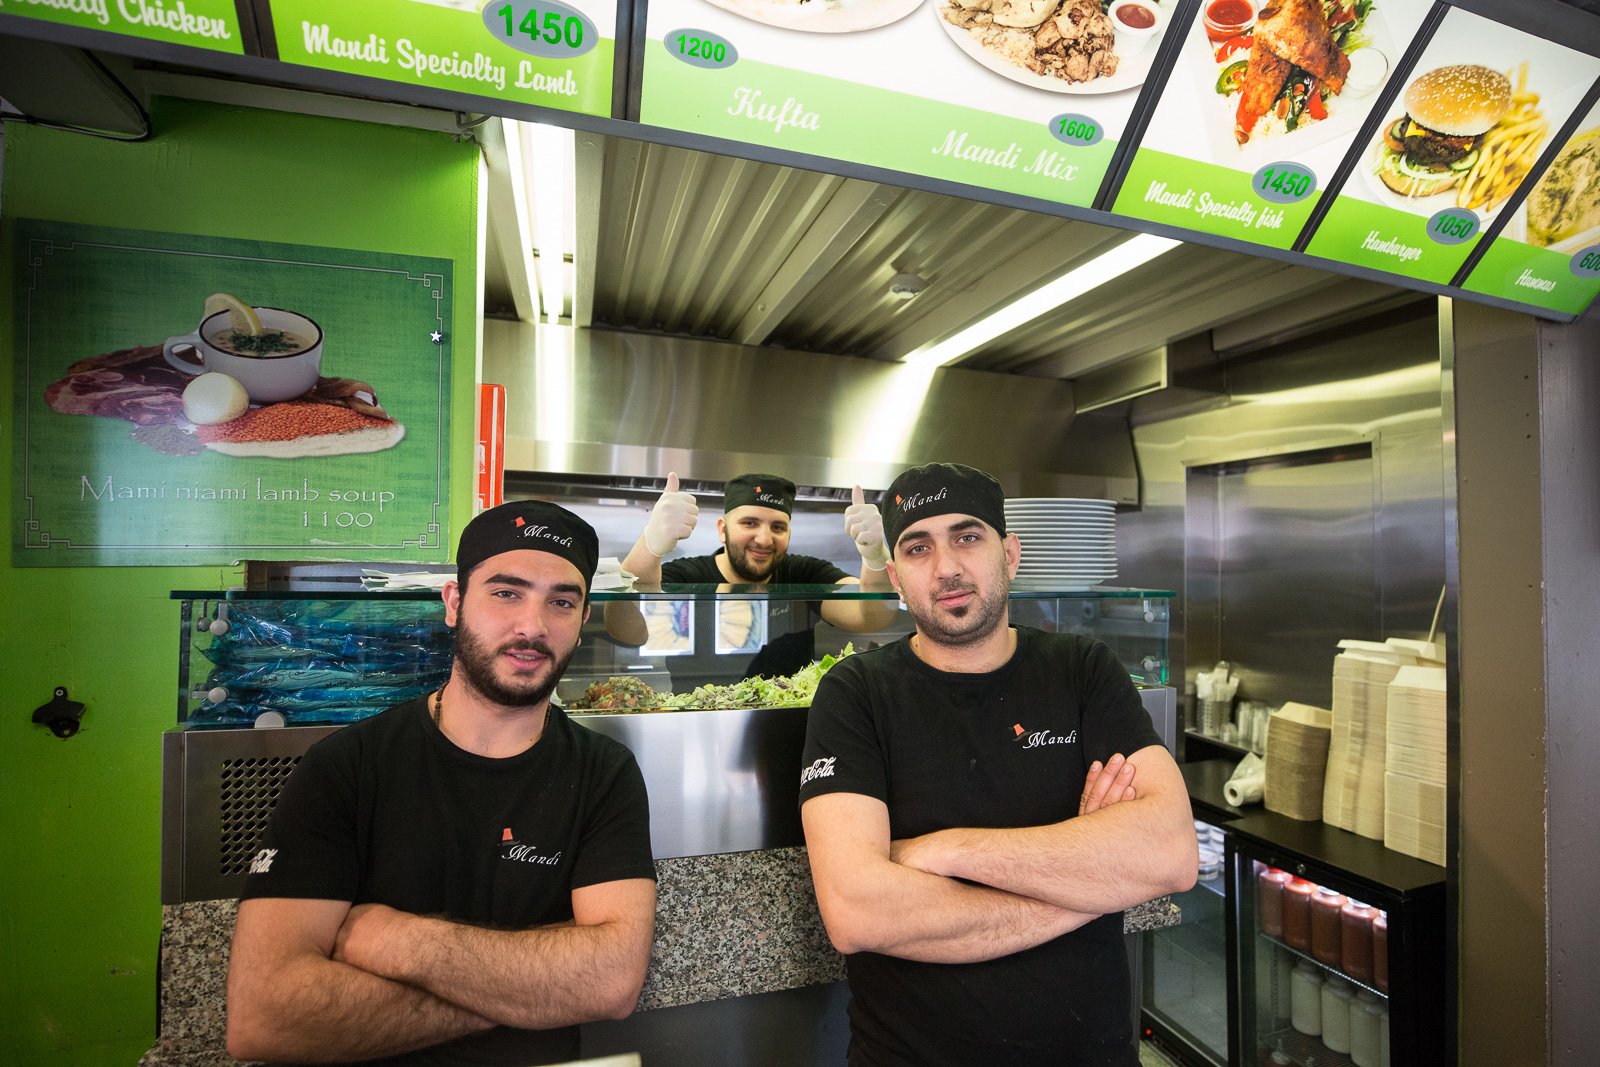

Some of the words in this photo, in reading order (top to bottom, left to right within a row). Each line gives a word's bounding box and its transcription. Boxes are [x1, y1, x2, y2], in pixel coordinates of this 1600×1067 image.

[118, 0, 231, 39] Chicken
[498, 4, 583, 48] 1450
[302, 21, 389, 64] Mandi
[397, 39, 507, 90] Specialty
[514, 61, 578, 96] Lamb
[676, 34, 726, 63] 1200
[726, 87, 821, 132] Kufta
[1057, 117, 1097, 142] 1600
[931, 129, 1018, 169] Mandi
[1023, 147, 1080, 182] Mix
[1260, 167, 1312, 198] 1450
[1145, 180, 1194, 208] Mandi
[1196, 193, 1256, 228] Specialty
[1256, 205, 1284, 230] fish
[1434, 213, 1473, 240] 1050
[1361, 231, 1422, 261] Hamburger
[80, 475, 166, 501] Mami
[175, 481, 249, 501] niami
[257, 478, 320, 502] lamb
[329, 488, 395, 512] soup
[902, 487, 948, 512] Mandi
[521, 524, 573, 548] Mandi
[1022, 730, 1077, 749] Mandi
[501, 843, 561, 866] Mandi
